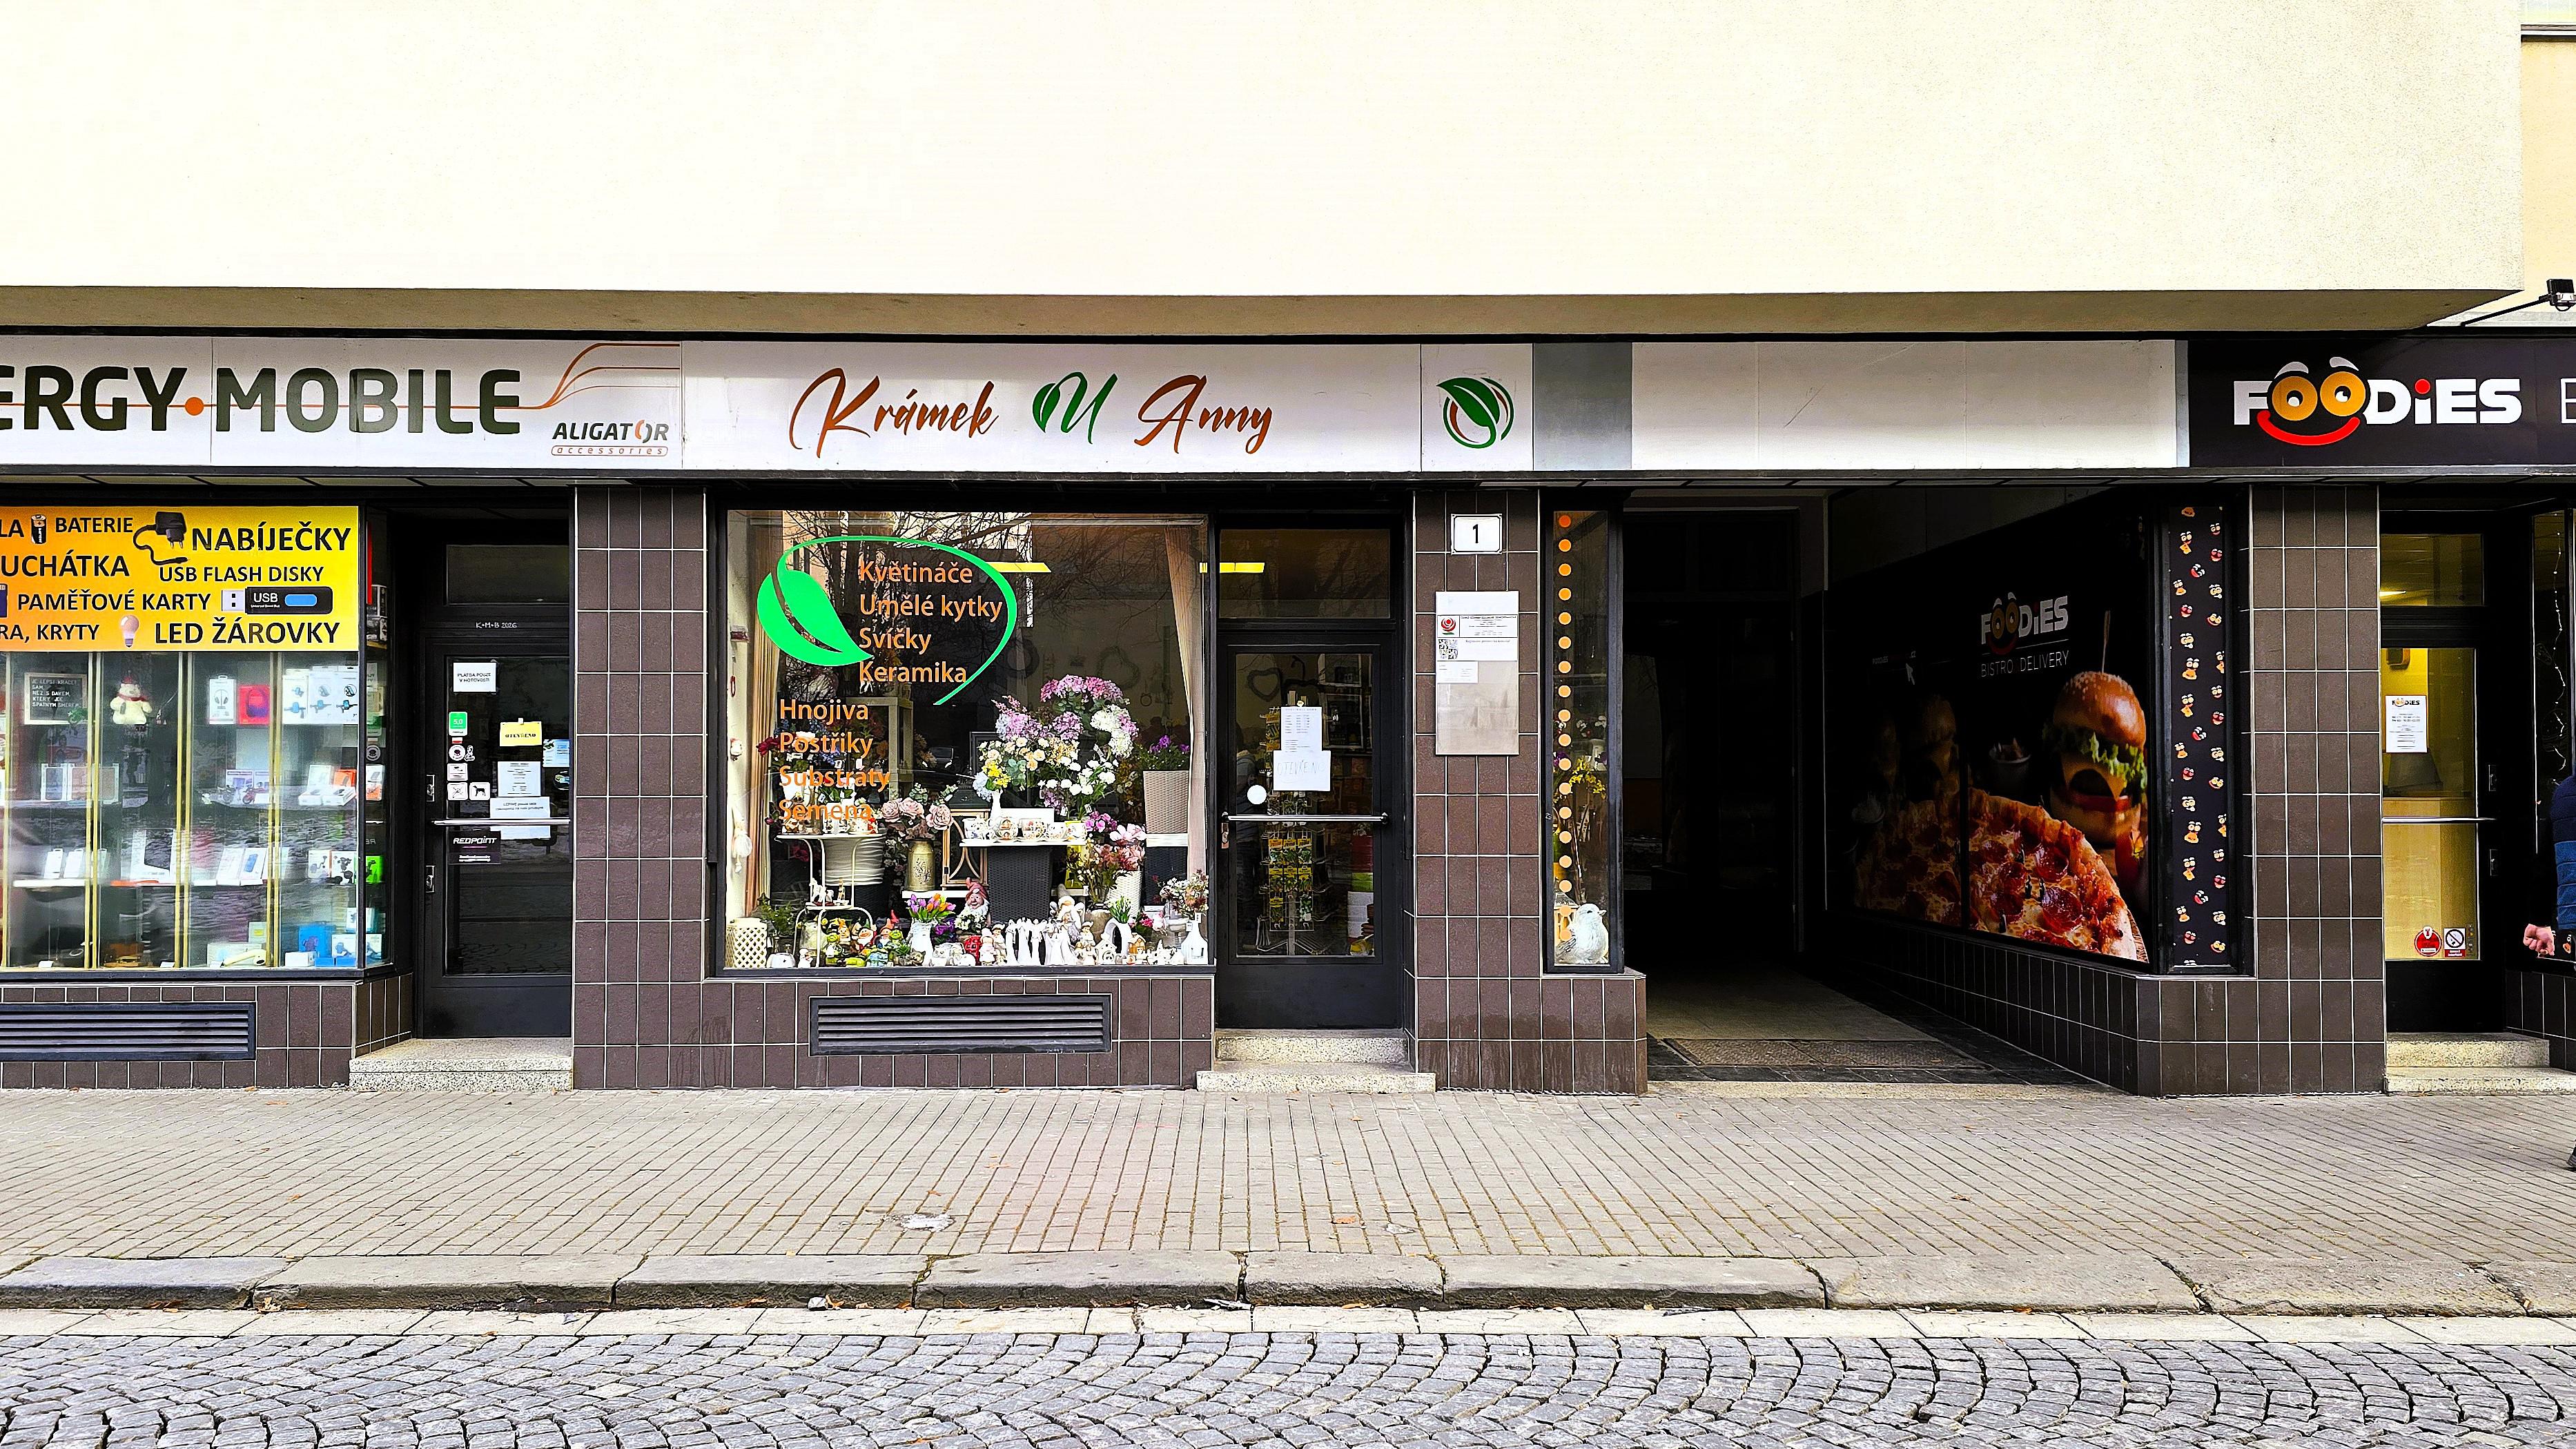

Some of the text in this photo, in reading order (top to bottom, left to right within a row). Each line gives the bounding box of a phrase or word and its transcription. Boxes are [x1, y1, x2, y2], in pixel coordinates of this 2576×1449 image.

[216, 367, 521, 434] MOBILE
[789, 367, 1273, 458] Krámek U Anny
[552, 420, 669, 443] ALIGATOR
[557, 447, 663, 455] accessories
[55, 517, 133, 533] BATERIE
[192, 521, 351, 551] NABÍJEČKY
[1472, 523, 1479, 544] 1
[1, 550, 130, 577] UCHÁTKA
[159, 566, 324, 583] USB FLASH DISKY
[859, 561, 973, 584] Květináče
[18, 588, 211, 610] PAMĚŤOVÉ KARTY
[253, 593, 278, 603] USB
[859, 594, 1003, 623] Umělé kytky
[37, 624, 100, 640] KRYTY
[155, 616, 340, 644] LED ŽÁROVKY
[859, 627, 932, 654] Svíčky
[859, 661, 966, 683] Keramika
[1981, 650, 2069, 677] BISTRO DELIVERY
[780, 699, 869, 726] Hnojiva
[780, 732, 874, 759] Postřiky
[779, 765, 891, 792] Substráty
[779, 799, 873, 821] Semena
